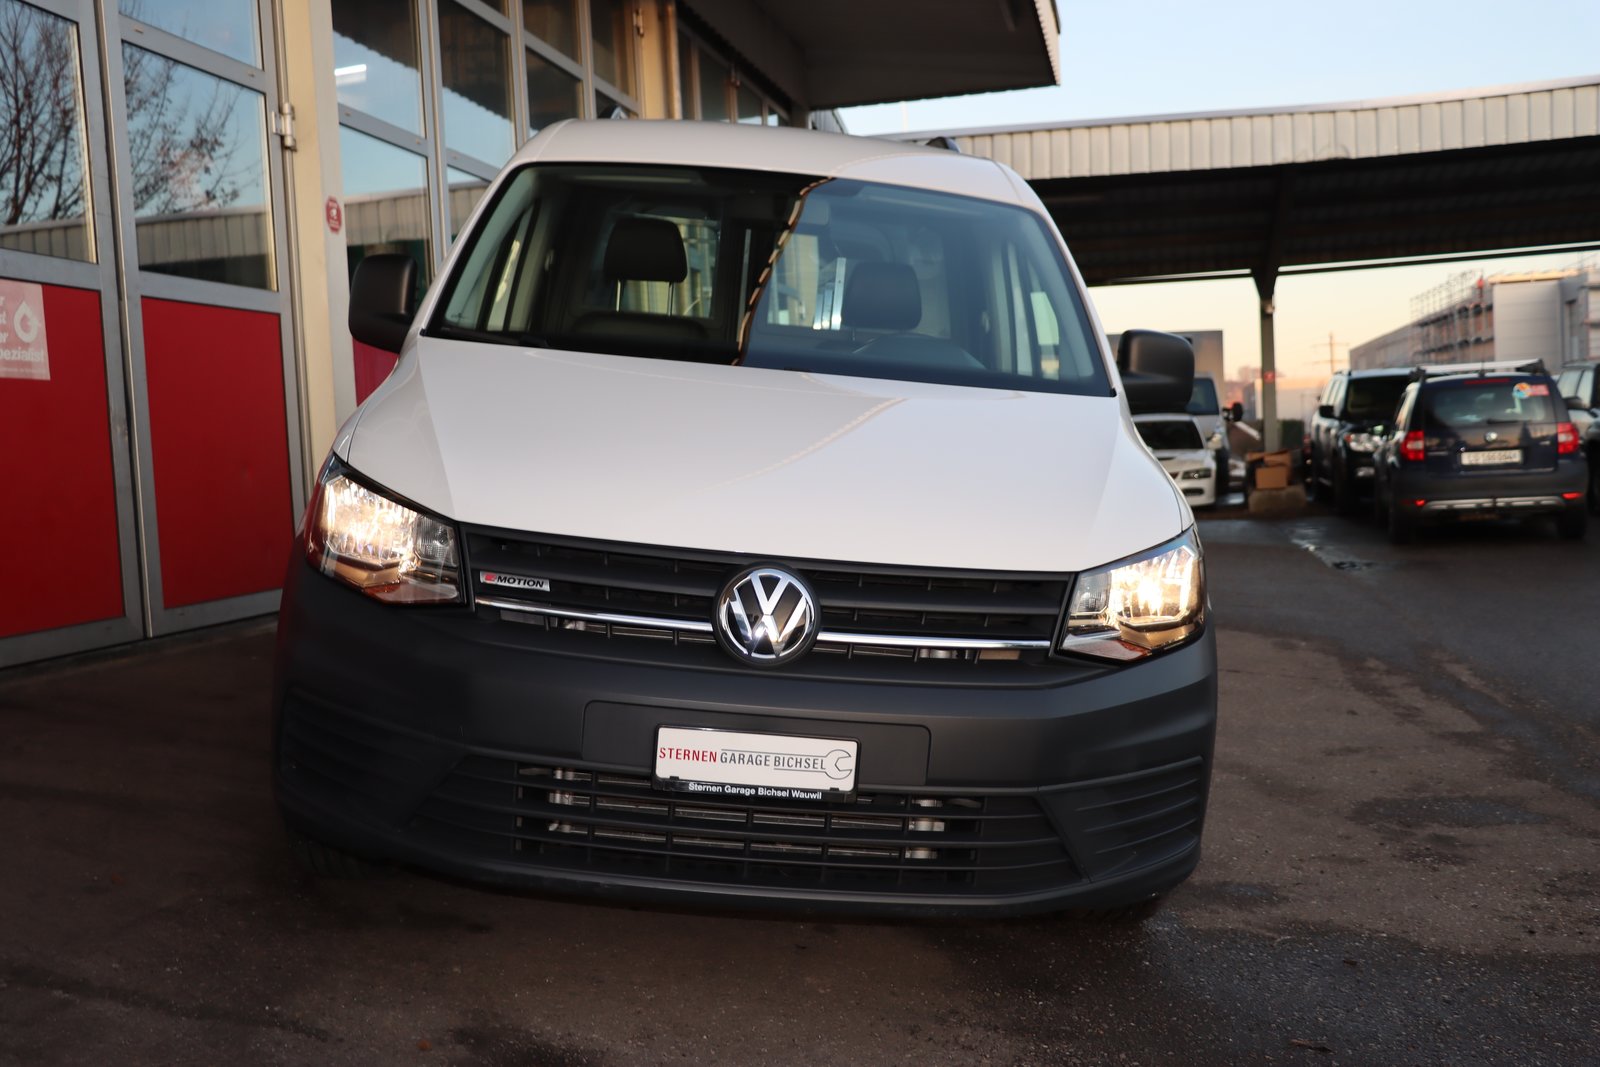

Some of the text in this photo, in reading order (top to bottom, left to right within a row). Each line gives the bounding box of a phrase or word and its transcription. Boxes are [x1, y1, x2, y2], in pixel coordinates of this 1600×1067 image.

[659, 747, 826, 770] STERNEN GARAGE BICHSEL
[688, 782, 822, 800] Sternen Garage Bichsel Wauwil
